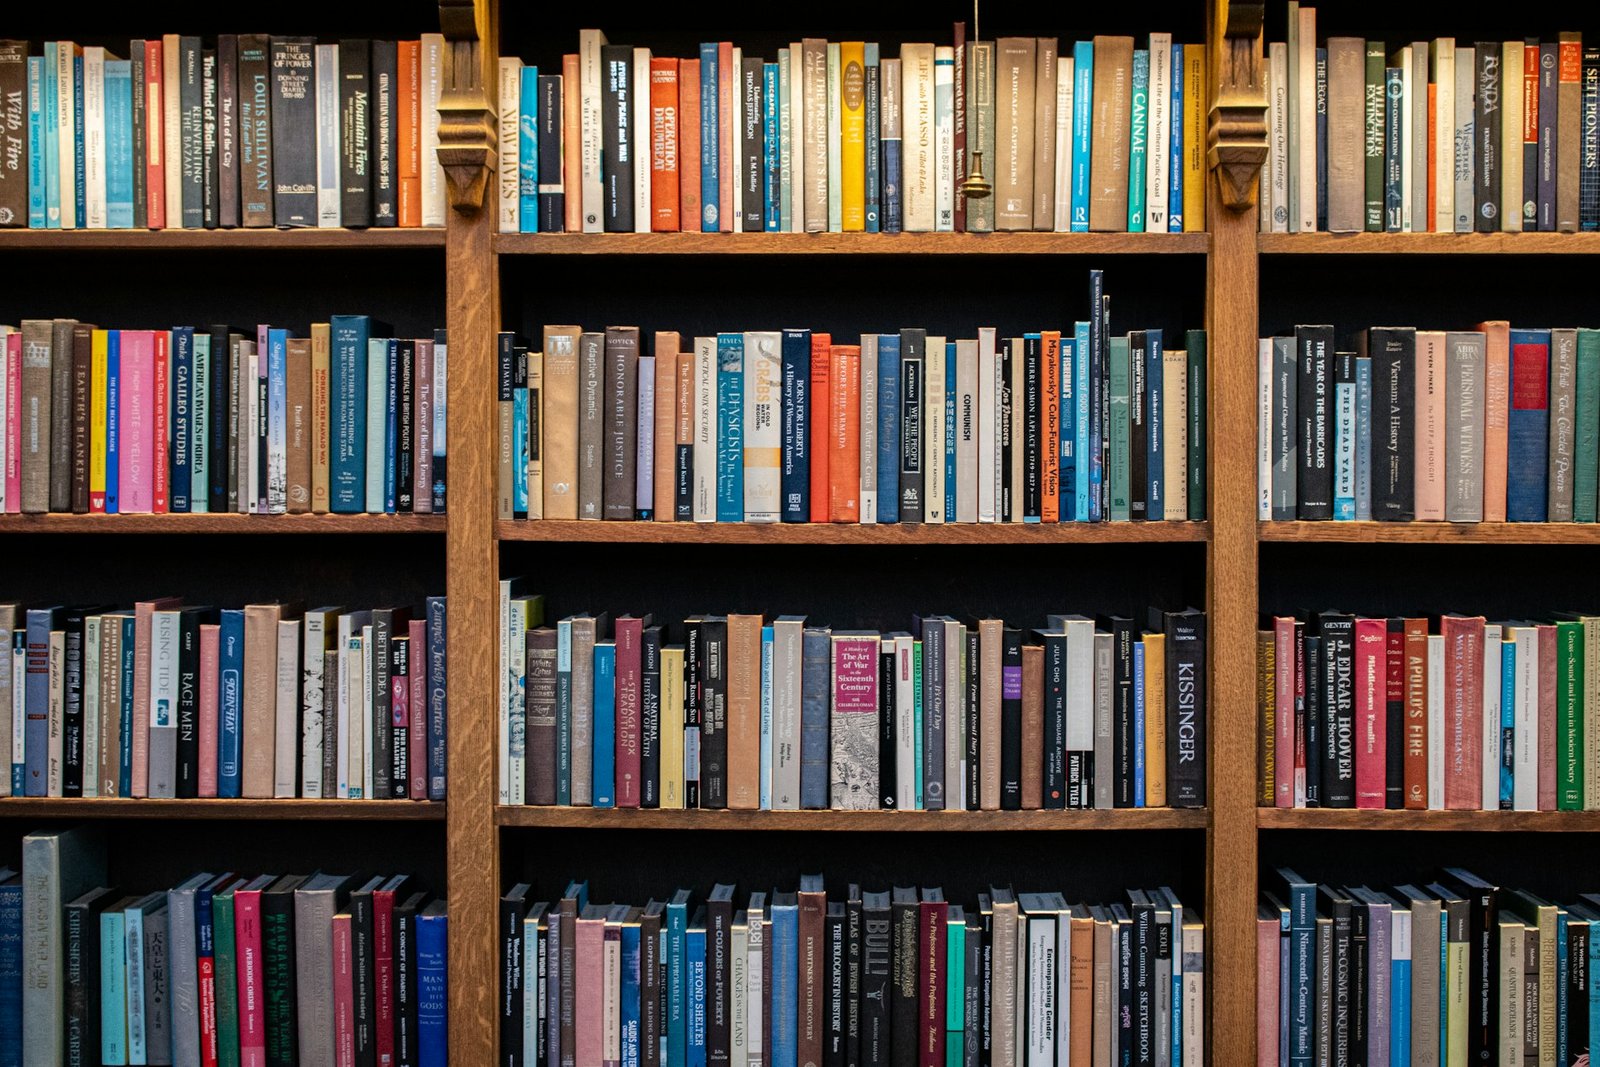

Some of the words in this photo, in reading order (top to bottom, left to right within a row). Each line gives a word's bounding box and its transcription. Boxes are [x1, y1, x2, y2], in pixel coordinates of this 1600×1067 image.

[204, 57, 214, 77] The
[815, 52, 824, 74] ALL
[204, 78, 214, 106] Mind
[254, 75, 266, 116] LOUIS
[816, 78, 825, 99] THE
[1317, 80, 1326, 114] LEGACY
[1483, 56, 1498, 114] FONDA
[1586, 68, 1596, 98] SETI
[6, 91, 21, 130] With
[183, 110, 192, 130] THE
[204, 108, 214, 121] of
[355, 91, 366, 147] Mountain
[502, 108, 516, 147] NEW
[745, 102, 753, 139] JEFFERSON
[1132, 93, 1145, 153] CANNAE
[1275, 87, 1285, 133] Concerning
[1367, 84, 1375, 157] EXTINCTION
[1374, 85, 1384, 156] WILDLIFE
[7, 136, 21, 170] Fire
[192, 106, 202, 183] REINVENTING
[204, 123, 214, 154] Stalin
[653, 108, 664, 171] DRUMBEAT
[664, 107, 675, 171] OPERATION
[816, 103, 825, 175] PRESIDENT'S
[1586, 103, 1596, 168] PIONEERS
[184, 136, 192, 177] BAZAAR
[255, 120, 268, 190] SULLIVAN
[355, 150, 367, 175] Fires
[1275, 154, 1284, 190] Heritage
[502, 152, 517, 199] LIVES
[817, 179, 826, 204] MEN
[177, 335, 187, 359] Drake
[586, 343, 597, 378] Adaptive
[756, 360, 769, 402] CRABS
[784, 373, 793, 397] History
[1047, 339, 1057, 402] Mayakovsky's
[1316, 383, 1324, 394] OF
[1390, 360, 1400, 404] Vietnam:
[77, 372, 85, 422] EARTH'S
[176, 366, 186, 414] GALILEO
[587, 381, 597, 420] Dynamics
[615, 354, 624, 426] HONORABLE
[680, 379, 689, 415] Ecological
[1461, 364, 1473, 420] PERSONAL
[294, 406, 302, 426] Death
[701, 408, 709, 444] SECURITY
[785, 407, 793, 434] Women
[963, 394, 971, 441] COMMUNISM
[1391, 406, 1400, 415] A
[176, 418, 186, 465] STUDIES
[293, 429, 302, 448] Song
[1048, 404, 1057, 466] Cubo-Futurist
[1388, 418, 1400, 451] History
[1461, 425, 1472, 474] WITNESS
[75, 428, 84, 482] BLANKET
[614, 431, 624, 478] JUSTICE
[1048, 469, 1056, 496] Vision
[159, 616, 170, 661] RISING
[377, 621, 385, 629] A
[431, 601, 445, 644] Europe's
[377, 631, 386, 669] BETTER
[842, 652, 856, 660] The
[1327, 640, 1335, 661] The
[1337, 640, 1350, 652] J.
[159, 666, 169, 694] TIDE
[431, 645, 444, 685] Jewish
[838, 674, 874, 682] Sixteenth
[1327, 664, 1335, 683] Man
[182, 673, 193, 706] RACE
[224, 678, 235, 708] JOHN
[377, 671, 386, 696] IDEA
[840, 684, 872, 692] Century
[1327, 685, 1336, 702] and
[1337, 657, 1351, 711] EDGAR
[1409, 656, 1424, 718] APOLLO'S
[181, 711, 192, 741] MEN
[224, 708, 235, 733] HAY
[432, 688, 445, 735] Quarters
[762, 714, 770, 735] Living
[1178, 663, 1194, 763] KISSINGER
[1328, 704, 1336, 721] the
[1328, 723, 1336, 759] Secrets
[1338, 717, 1352, 780] HOOVER
[1409, 725, 1424, 756] FIRE
[1070, 756, 1079, 783] PATRICK
[1070, 785, 1078, 805] TYLER
[1140, 911, 1148, 944] William
[1159, 927, 1167, 956] SEOUL
[865, 919, 889, 975] BULL!
[1543, 938, 1554, 990] REFORMERS
[695, 961, 703, 1001] BEYOND
[1138, 946, 1148, 987] Cumming
[1297, 933, 1308, 1024] Nineteenth-Century
[807, 985, 813, 996] TO
[695, 1004, 703, 1046] SHELTER
[1140, 991, 1148, 1062] SKETCHBOOK
[1298, 1026, 1307, 1054] Music
[1543, 1006, 1555, 1062] VISIONARIES
